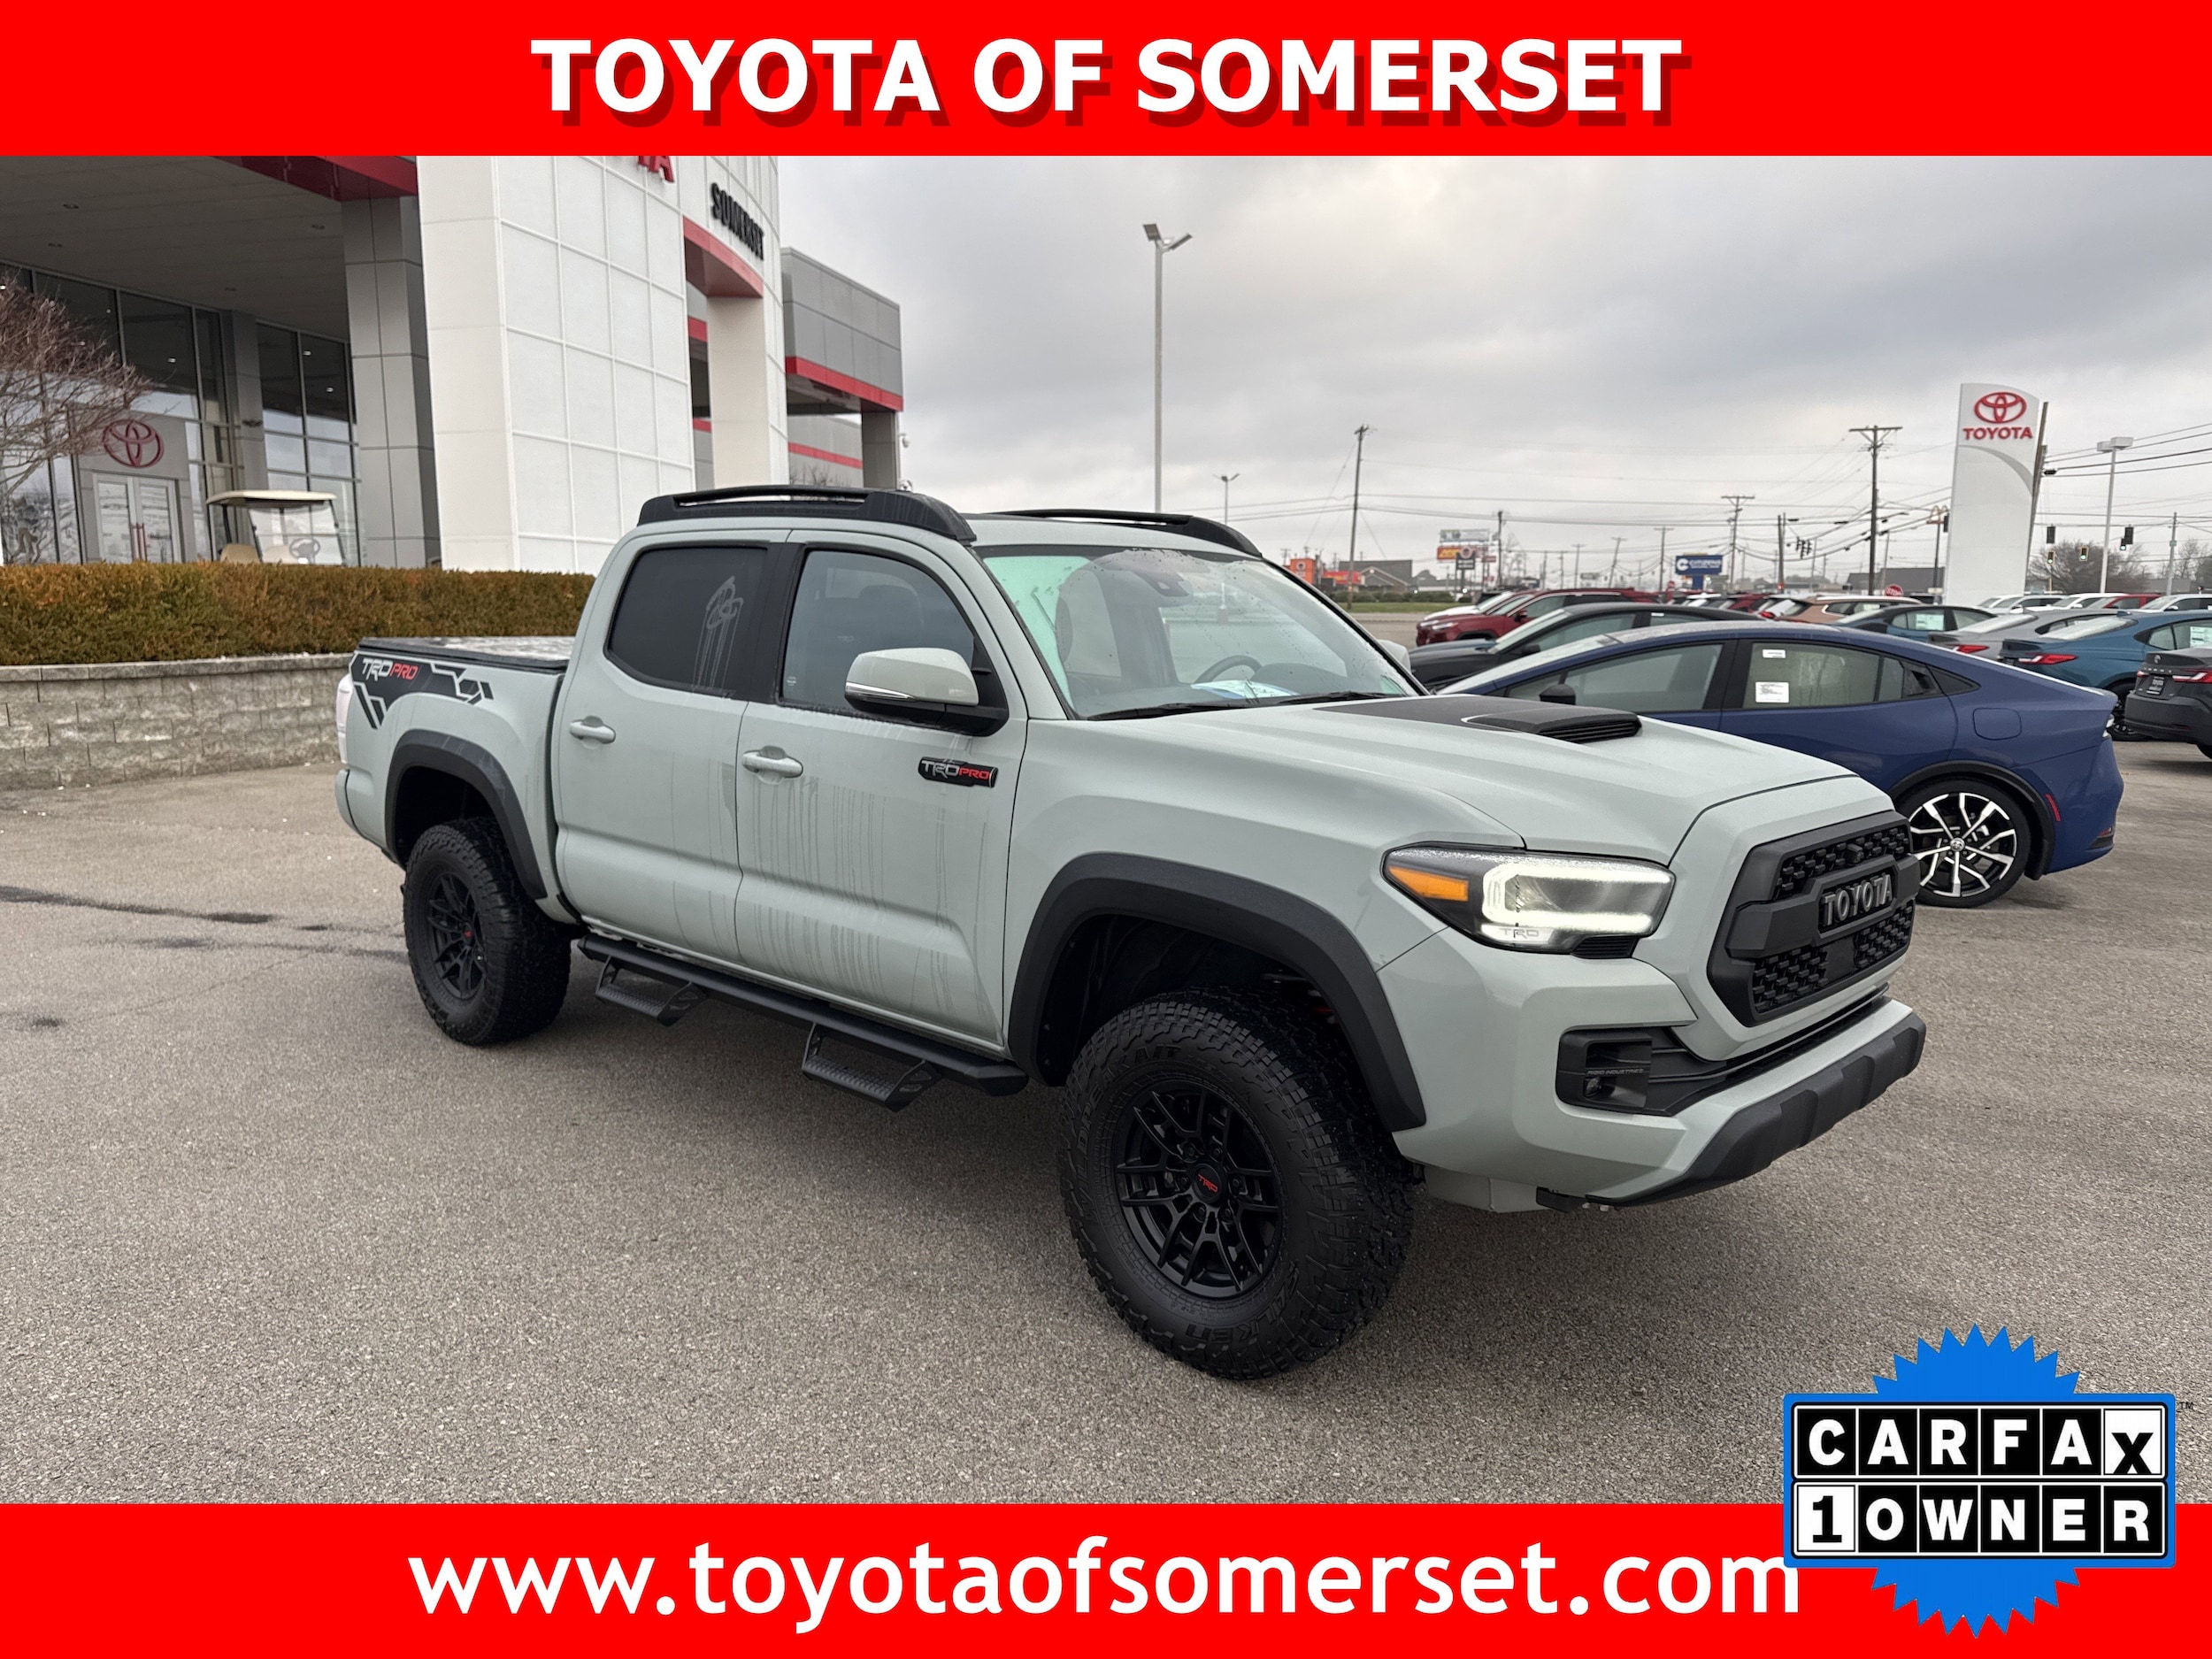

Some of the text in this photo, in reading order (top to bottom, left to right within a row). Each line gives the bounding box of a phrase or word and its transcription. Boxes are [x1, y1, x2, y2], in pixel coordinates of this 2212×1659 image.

[1962, 426, 2033, 440] TOYOTA
[362, 657, 419, 681] TRD PRO
[921, 760, 989, 780] TRD PRO
[1821, 872, 1893, 926] TOYOTA
[1499, 927, 1540, 940] TRD
[1197, 1173, 1218, 1194] TRD
